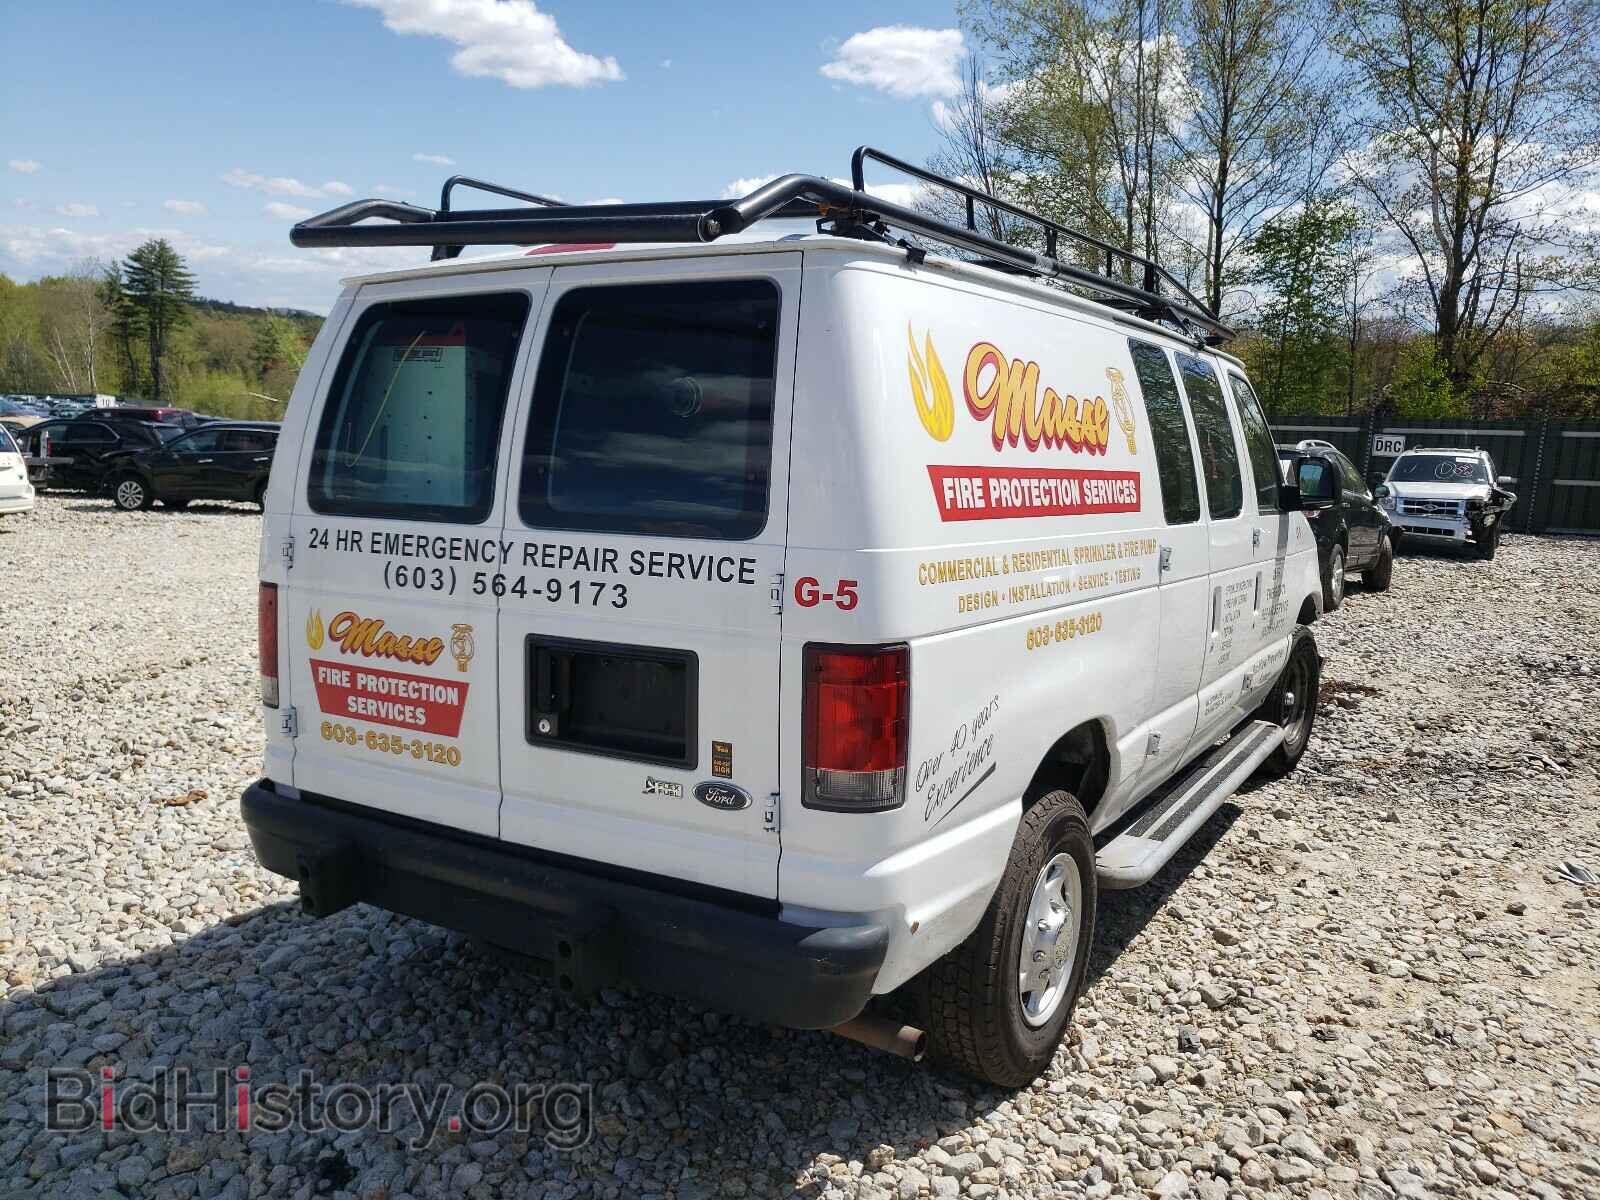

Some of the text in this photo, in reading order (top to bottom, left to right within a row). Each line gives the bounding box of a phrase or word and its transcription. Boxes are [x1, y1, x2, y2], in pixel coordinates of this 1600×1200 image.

[963, 341, 1110, 456] Masse
[1376, 439, 1402, 453] DRC
[942, 477, 1137, 509] FIRE PROTECTION SERVICES
[309, 528, 757, 585] 24 HR EMERGENCY REPAIR SERVICE
[917, 538, 1157, 586] COMMERCIAL & RESIDENTIAL SPRINKLER & FIRE PUMP
[384, 560, 628, 609] (603) 564-9173
[794, 576, 859, 611] G-5
[958, 567, 1141, 614] DESIGN INSTALLATION SERVICE TESTING
[328, 611, 445, 666] Masse
[1026, 611, 1103, 651] 603-635-3120
[318, 667, 459, 706] FIRE PROTECTION
[347, 695, 427, 726] SERVICES
[320, 719, 462, 767] 603-635-3120
[915, 694, 999, 793] Over 40 years
[658, 782, 680, 791] FLEX
[658, 788, 681, 798] FUEL
[705, 786, 736, 806] Ford
[925, 733, 994, 822] Experience
